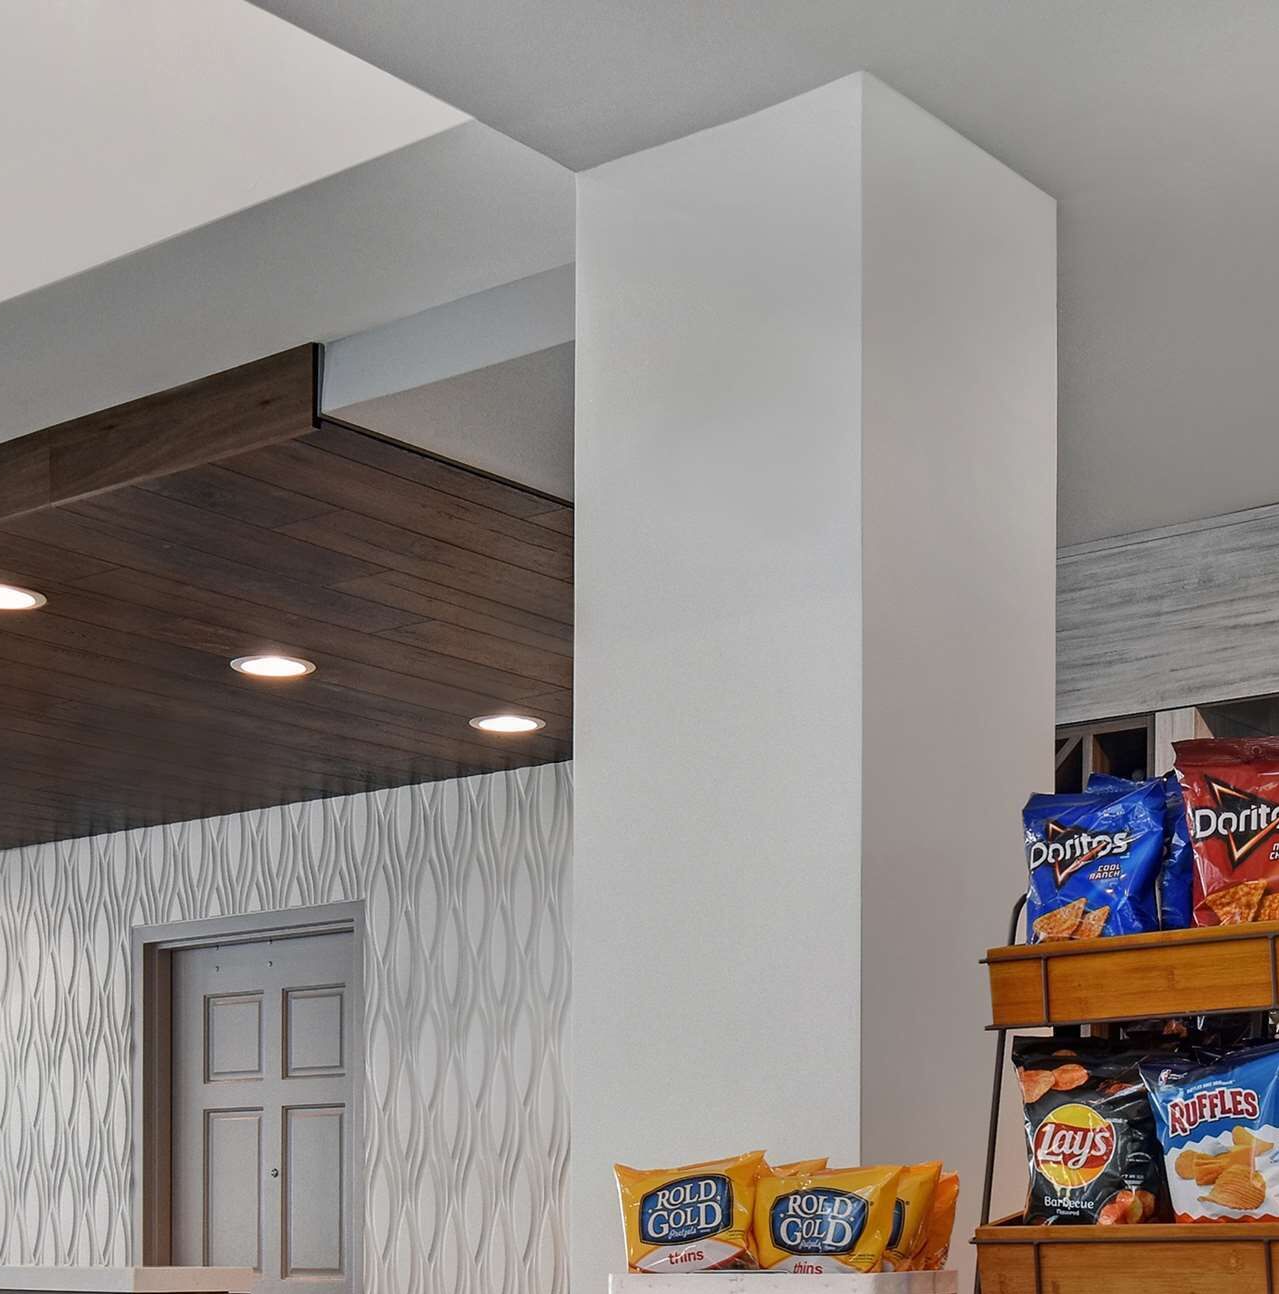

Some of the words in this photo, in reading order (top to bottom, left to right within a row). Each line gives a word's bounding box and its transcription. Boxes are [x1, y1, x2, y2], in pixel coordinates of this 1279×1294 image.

[1030, 831, 1129, 870] Doritos
[1088, 870, 1122, 881] RANCH
[1097, 863, 1121, 873] COOL
[1169, 1087, 1260, 1137] RUFFLES
[1037, 1122, 1110, 1169] Lay's
[655, 1179, 717, 1210] ROLD
[787, 1194, 852, 1218] ROLD
[1044, 1195, 1095, 1211] Barbecue
[647, 1201, 723, 1238] GOLD
[780, 1217, 853, 1246] GOLD
[668, 1250, 704, 1265] thins
[793, 1261, 823, 1274] thins
